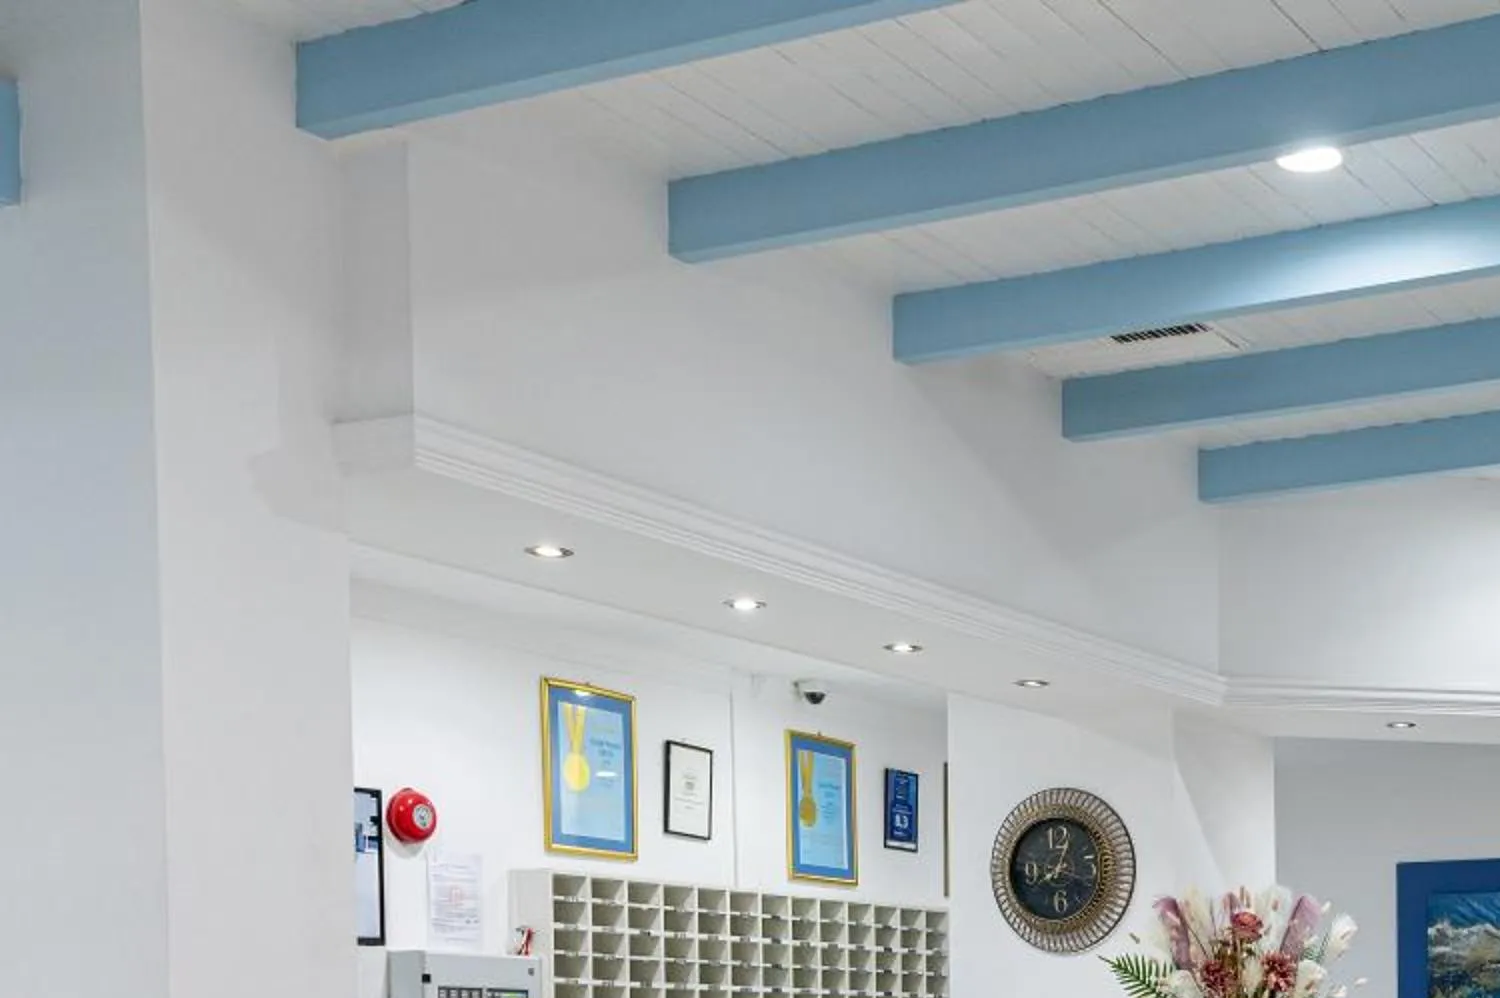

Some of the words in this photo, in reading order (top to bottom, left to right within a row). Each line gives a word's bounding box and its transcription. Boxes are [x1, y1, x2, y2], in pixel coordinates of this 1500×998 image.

[1047, 826, 1069, 849] 12
[1024, 861, 1038, 886] 9
[1053, 890, 1068, 913] 6
